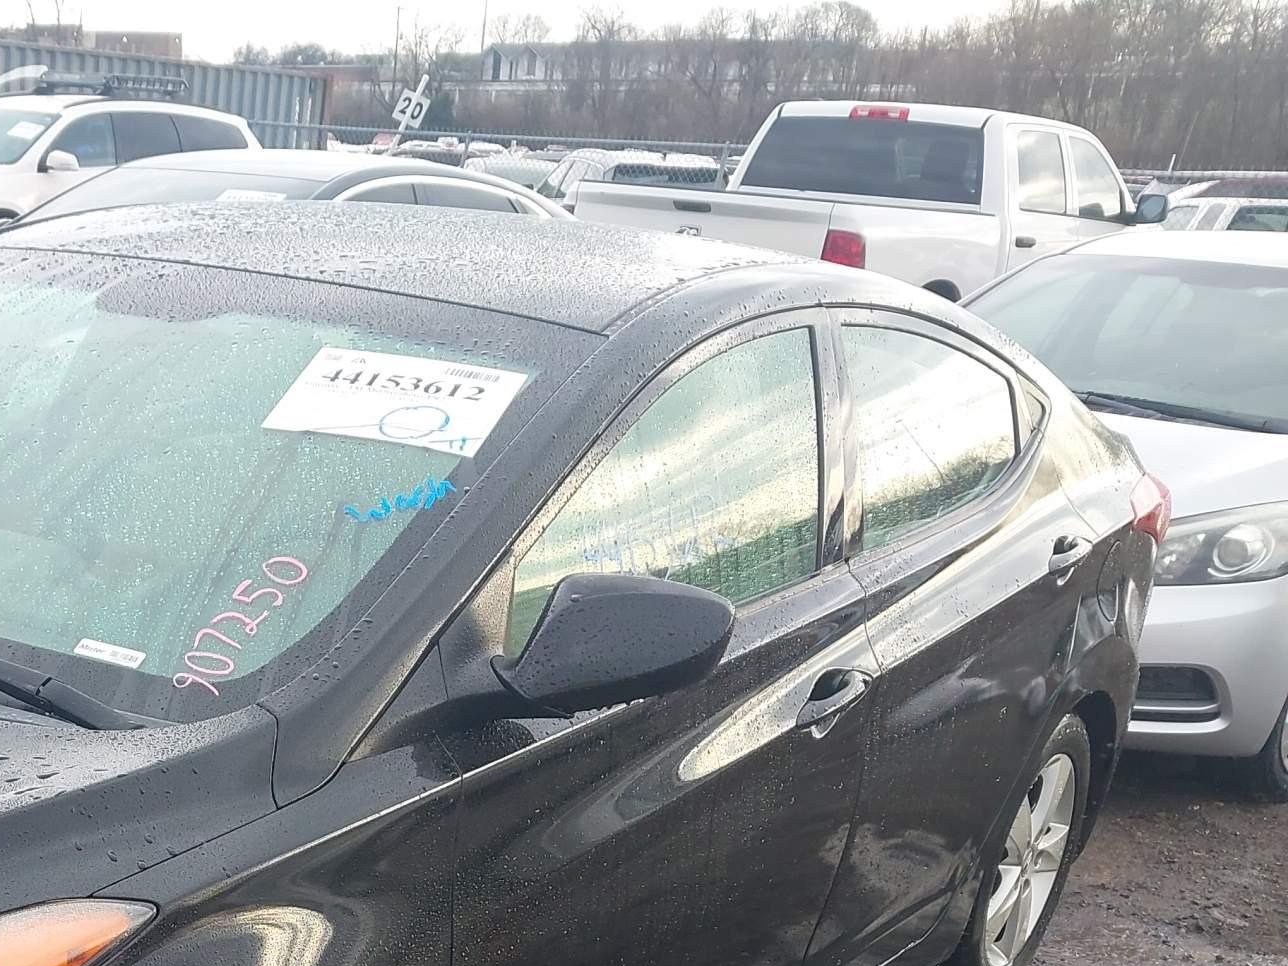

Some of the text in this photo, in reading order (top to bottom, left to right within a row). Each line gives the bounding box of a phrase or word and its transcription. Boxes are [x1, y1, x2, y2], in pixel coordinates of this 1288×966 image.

[398, 96, 424, 120] 20
[321, 368, 486, 402] 44153612
[172, 556, 308, 697] 907250
